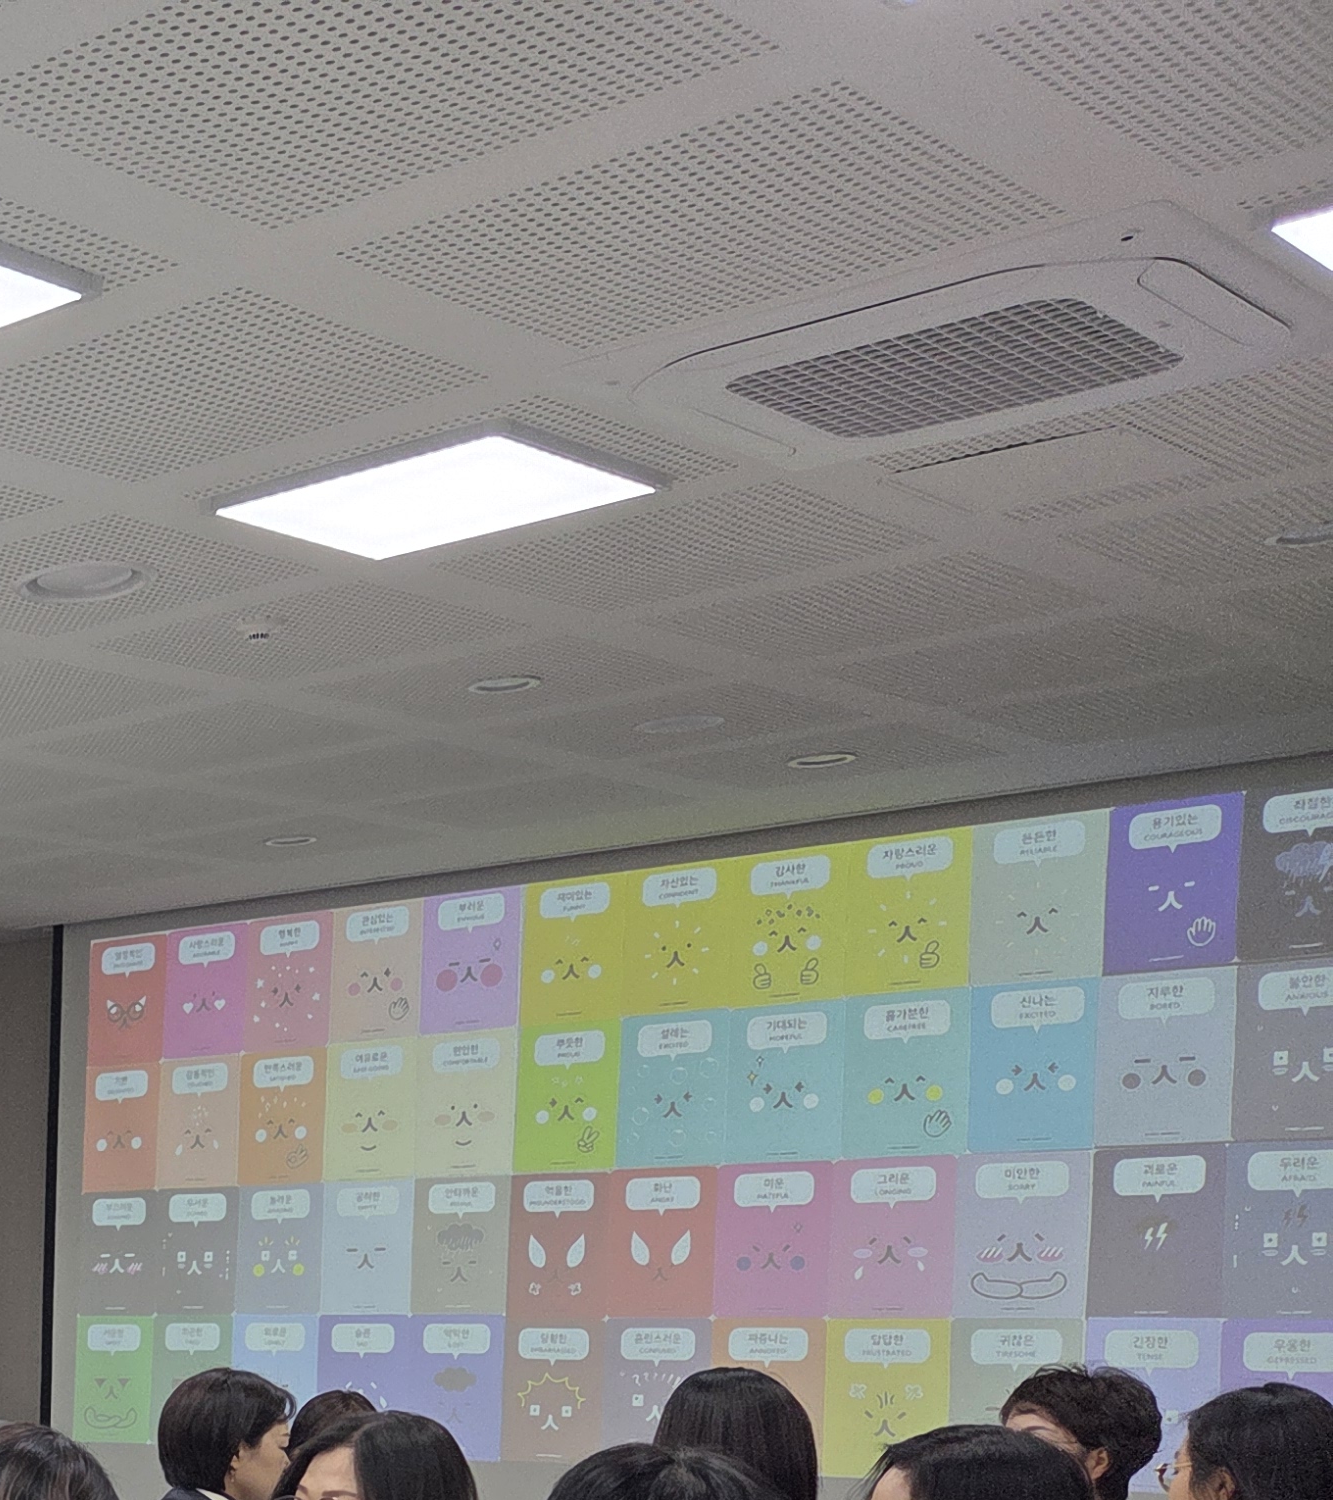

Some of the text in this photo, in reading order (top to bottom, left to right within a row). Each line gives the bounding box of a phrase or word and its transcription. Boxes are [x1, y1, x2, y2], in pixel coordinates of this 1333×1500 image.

[1153, 814, 1199, 829] 용기있는
[1144, 829, 1203, 841] COURAGEOUS
[883, 844, 937, 860] 자랑스러운
[776, 863, 806, 876] 감사한
[459, 901, 484, 912] 부러운
[189, 937, 224, 949] 사랑스러운
[1289, 974, 1329, 989] 불안한
[1147, 985, 1184, 998] 지루한
[1285, 991, 1328, 1002] ANXIOUS
[1020, 995, 1057, 1007] 신나는
[1150, 1002, 1180, 1010] BORED
[1019, 1011, 1056, 1019] EXCITED
[766, 1019, 807, 1030] 기대되는
[661, 1028, 689, 1039] 설레는
[1143, 1163, 1178, 1176] 괴로운
[1280, 1158, 1319, 1171] 두려운
[877, 1174, 909, 1185] 그리운
[1005, 1168, 1040, 1180] 미안한
[1281, 1174, 1317, 1182] AFRAID
[654, 1183, 672, 1193] 화난
[764, 1178, 784, 1189] 미운
[1142, 1180, 1176, 1188] PAINFUL
[445, 1188, 478, 1198] 안타까운
[546, 1186, 572, 1195] 억울한
[634, 1333, 681, 1344] 혼란스러운
[748, 1334, 788, 1344] 짜증나는
[872, 1335, 903, 1346] 답답한
[999, 1335, 1034, 1347] 귀찮은
[1132, 1336, 1168, 1349] 긴장한
[1274, 1339, 1311, 1352] 우울한
